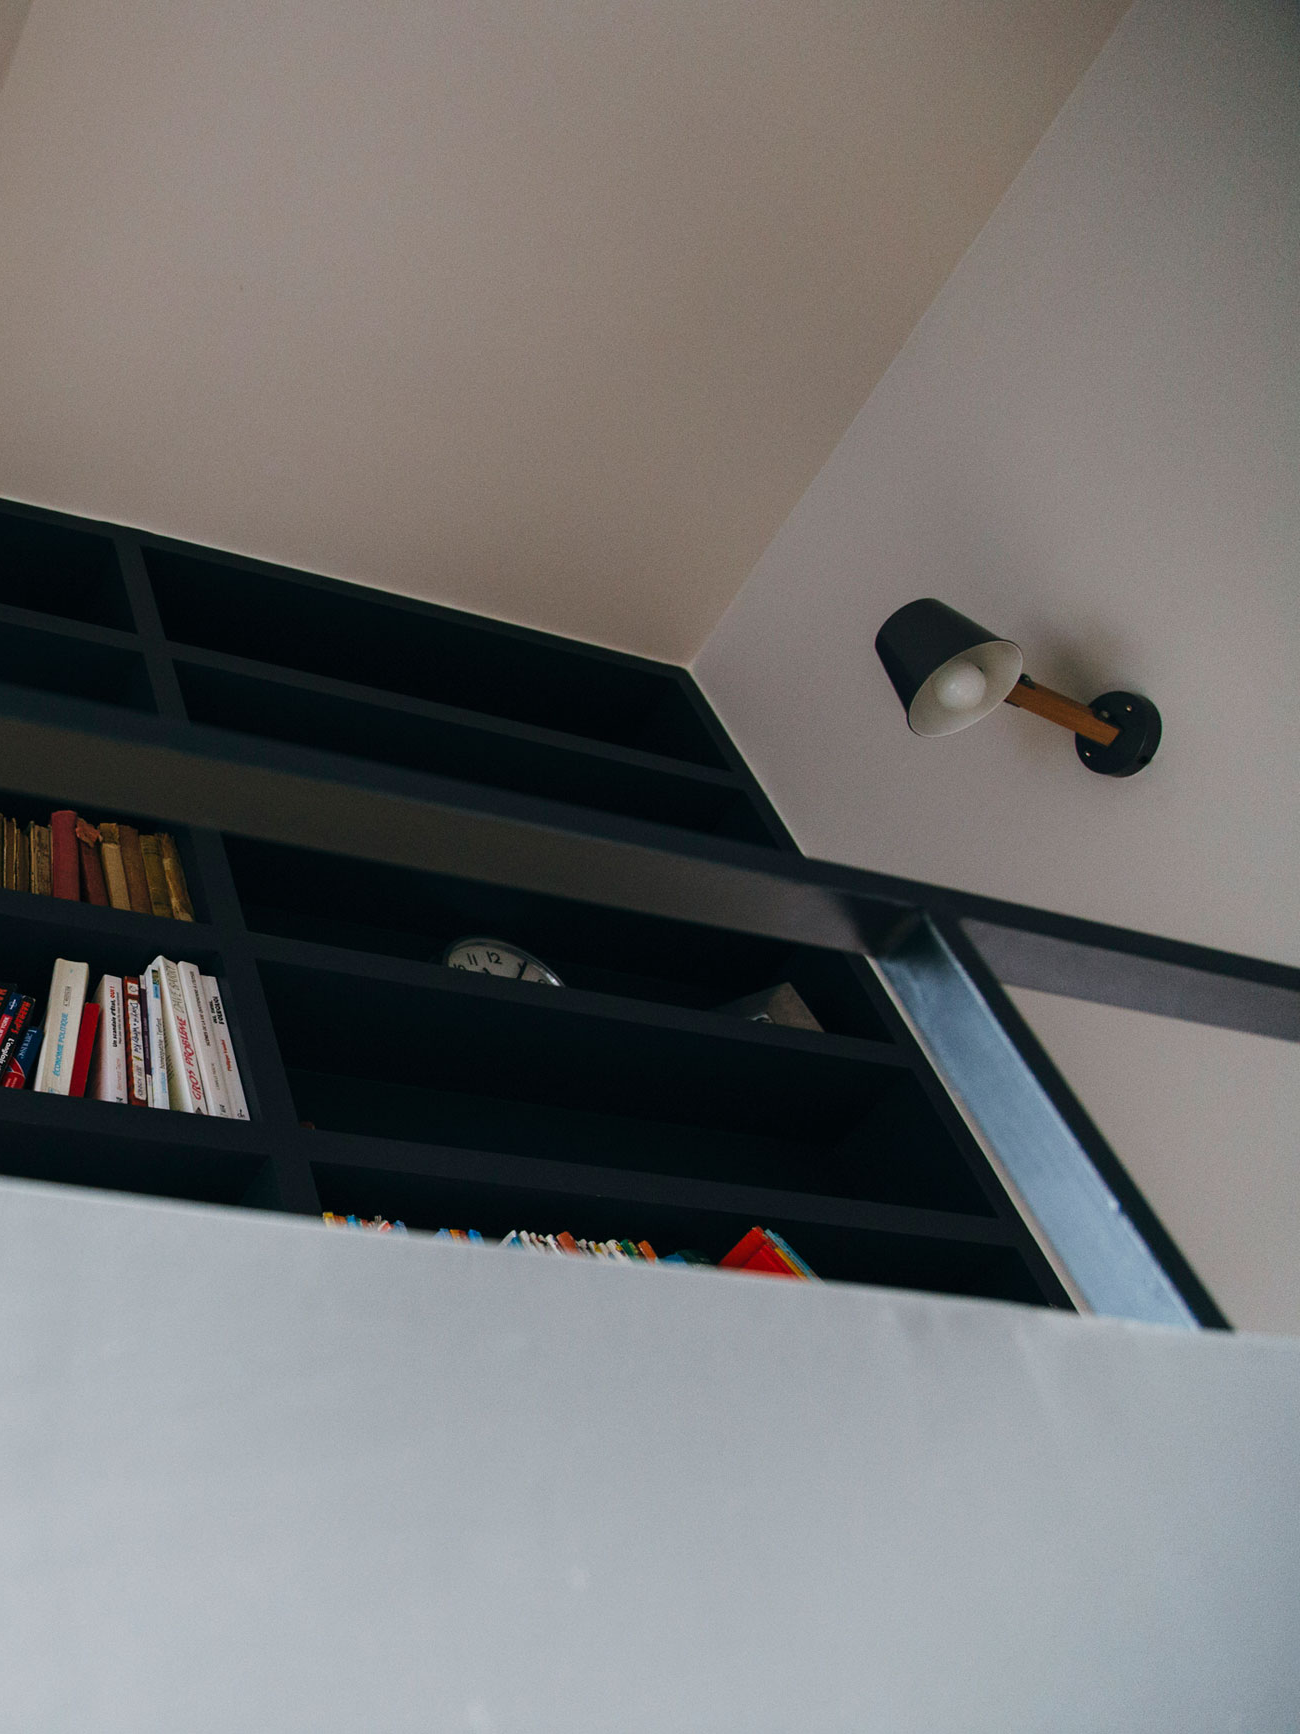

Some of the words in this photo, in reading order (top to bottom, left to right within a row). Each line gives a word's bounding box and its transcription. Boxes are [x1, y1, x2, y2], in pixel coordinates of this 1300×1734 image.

[466, 952, 478, 966] 11
[486, 951, 503, 965] 12
[165, 964, 180, 992] BARRY
[171, 989, 186, 1014] DAVE
[10, 1000, 32, 1035] HARRAP'S
[58, 1012, 69, 1043] POLITIQUE
[52, 1040, 65, 1077] ÉCONOMIE
[187, 1069, 202, 1101] GROS
